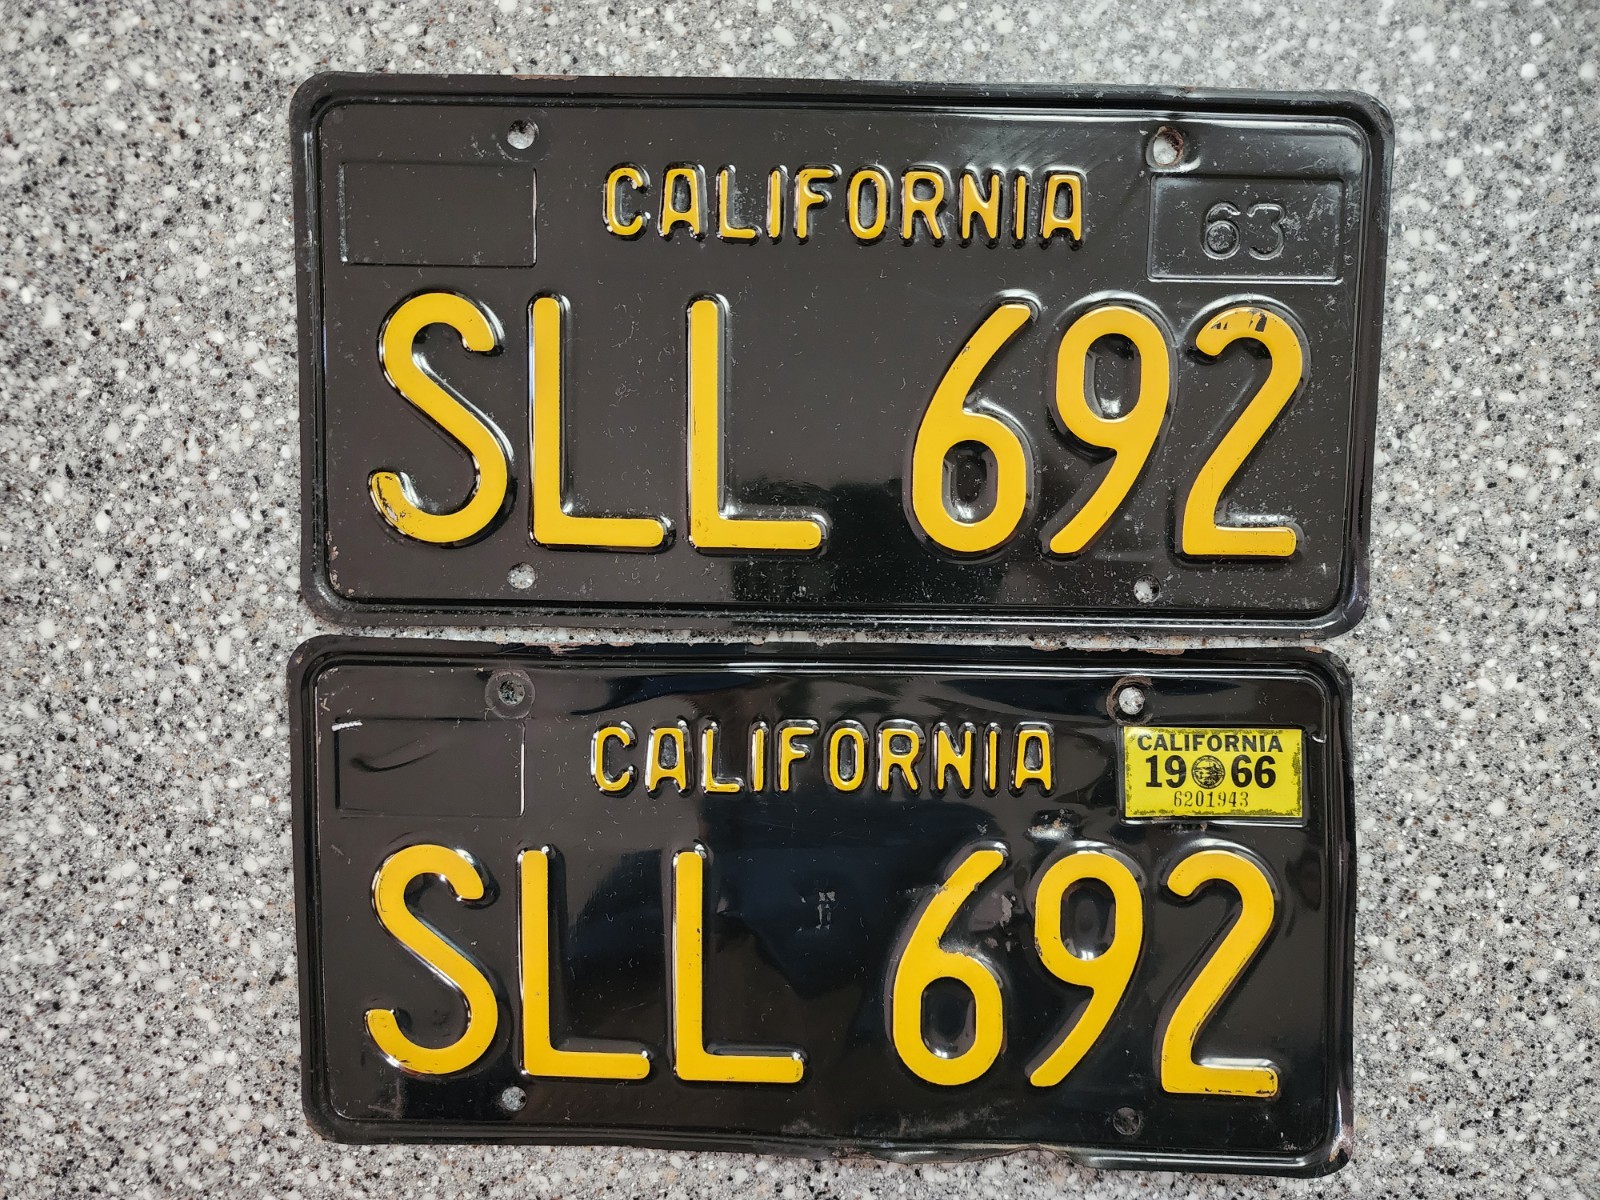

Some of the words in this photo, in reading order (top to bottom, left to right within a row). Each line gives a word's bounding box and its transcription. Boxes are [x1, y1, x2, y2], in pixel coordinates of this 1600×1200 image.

[604, 163, 1083, 242] CALIFORNIA
[1201, 202, 1285, 260] 63
[369, 291, 824, 550] SLL
[910, 291, 1306, 558] 692
[592, 722, 1053, 793] CALIFORNIA
[1137, 733, 1283, 753] CALIFORNIA
[1145, 754, 1187, 788] 19
[1231, 755, 1276, 788] 66
[1173, 790, 1249, 808] 6201943
[365, 843, 806, 1084] SLL
[891, 848, 1280, 1098] 692
